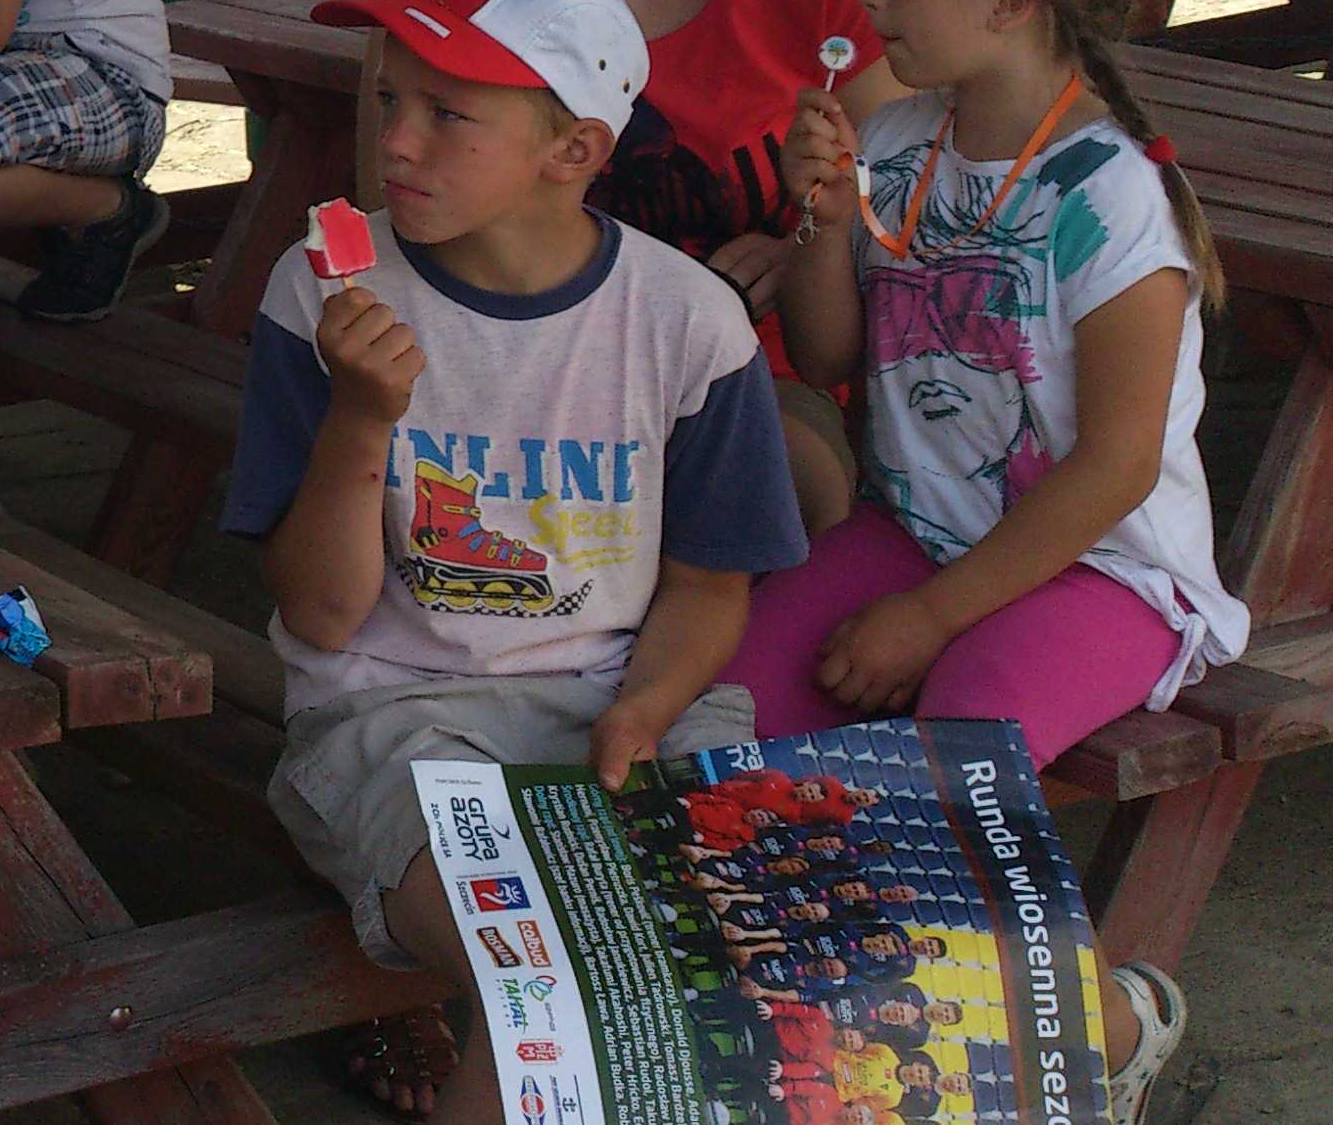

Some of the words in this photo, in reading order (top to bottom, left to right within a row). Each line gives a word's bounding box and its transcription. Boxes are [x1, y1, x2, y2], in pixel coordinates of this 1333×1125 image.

[961, 759, 1022, 860] Runda
[1004, 865, 1062, 1039] wiosenna
[627, 1004, 647, 1058] Sebastian
[673, 1008, 687, 1047] Donald
[603, 1025, 619, 1061] Adrian
[611, 1064, 627, 1101] Budka,
[621, 1041, 635, 1070] Peter
[664, 1041, 679, 1081] Tomasz
